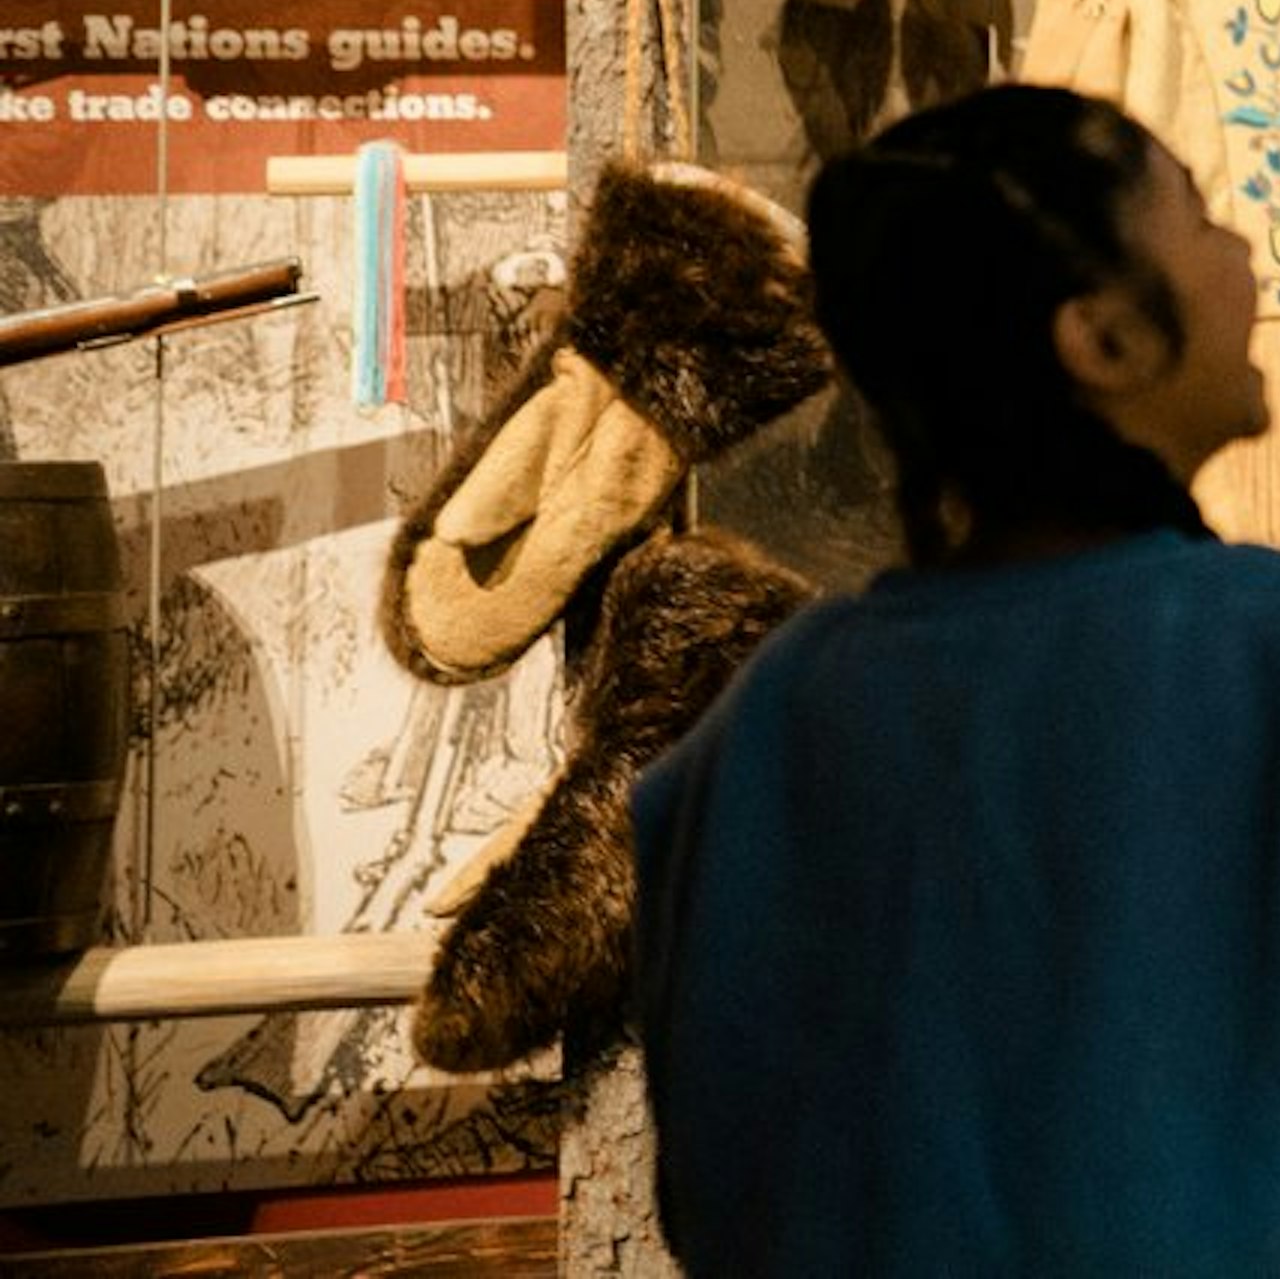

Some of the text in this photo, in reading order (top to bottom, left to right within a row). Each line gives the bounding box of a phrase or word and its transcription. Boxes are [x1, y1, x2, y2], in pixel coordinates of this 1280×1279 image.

[82, 13, 311, 61] Nations
[327, 14, 536, 71] guides.
[68, 83, 193, 122] trade
[205, 84, 493, 122] connections.
